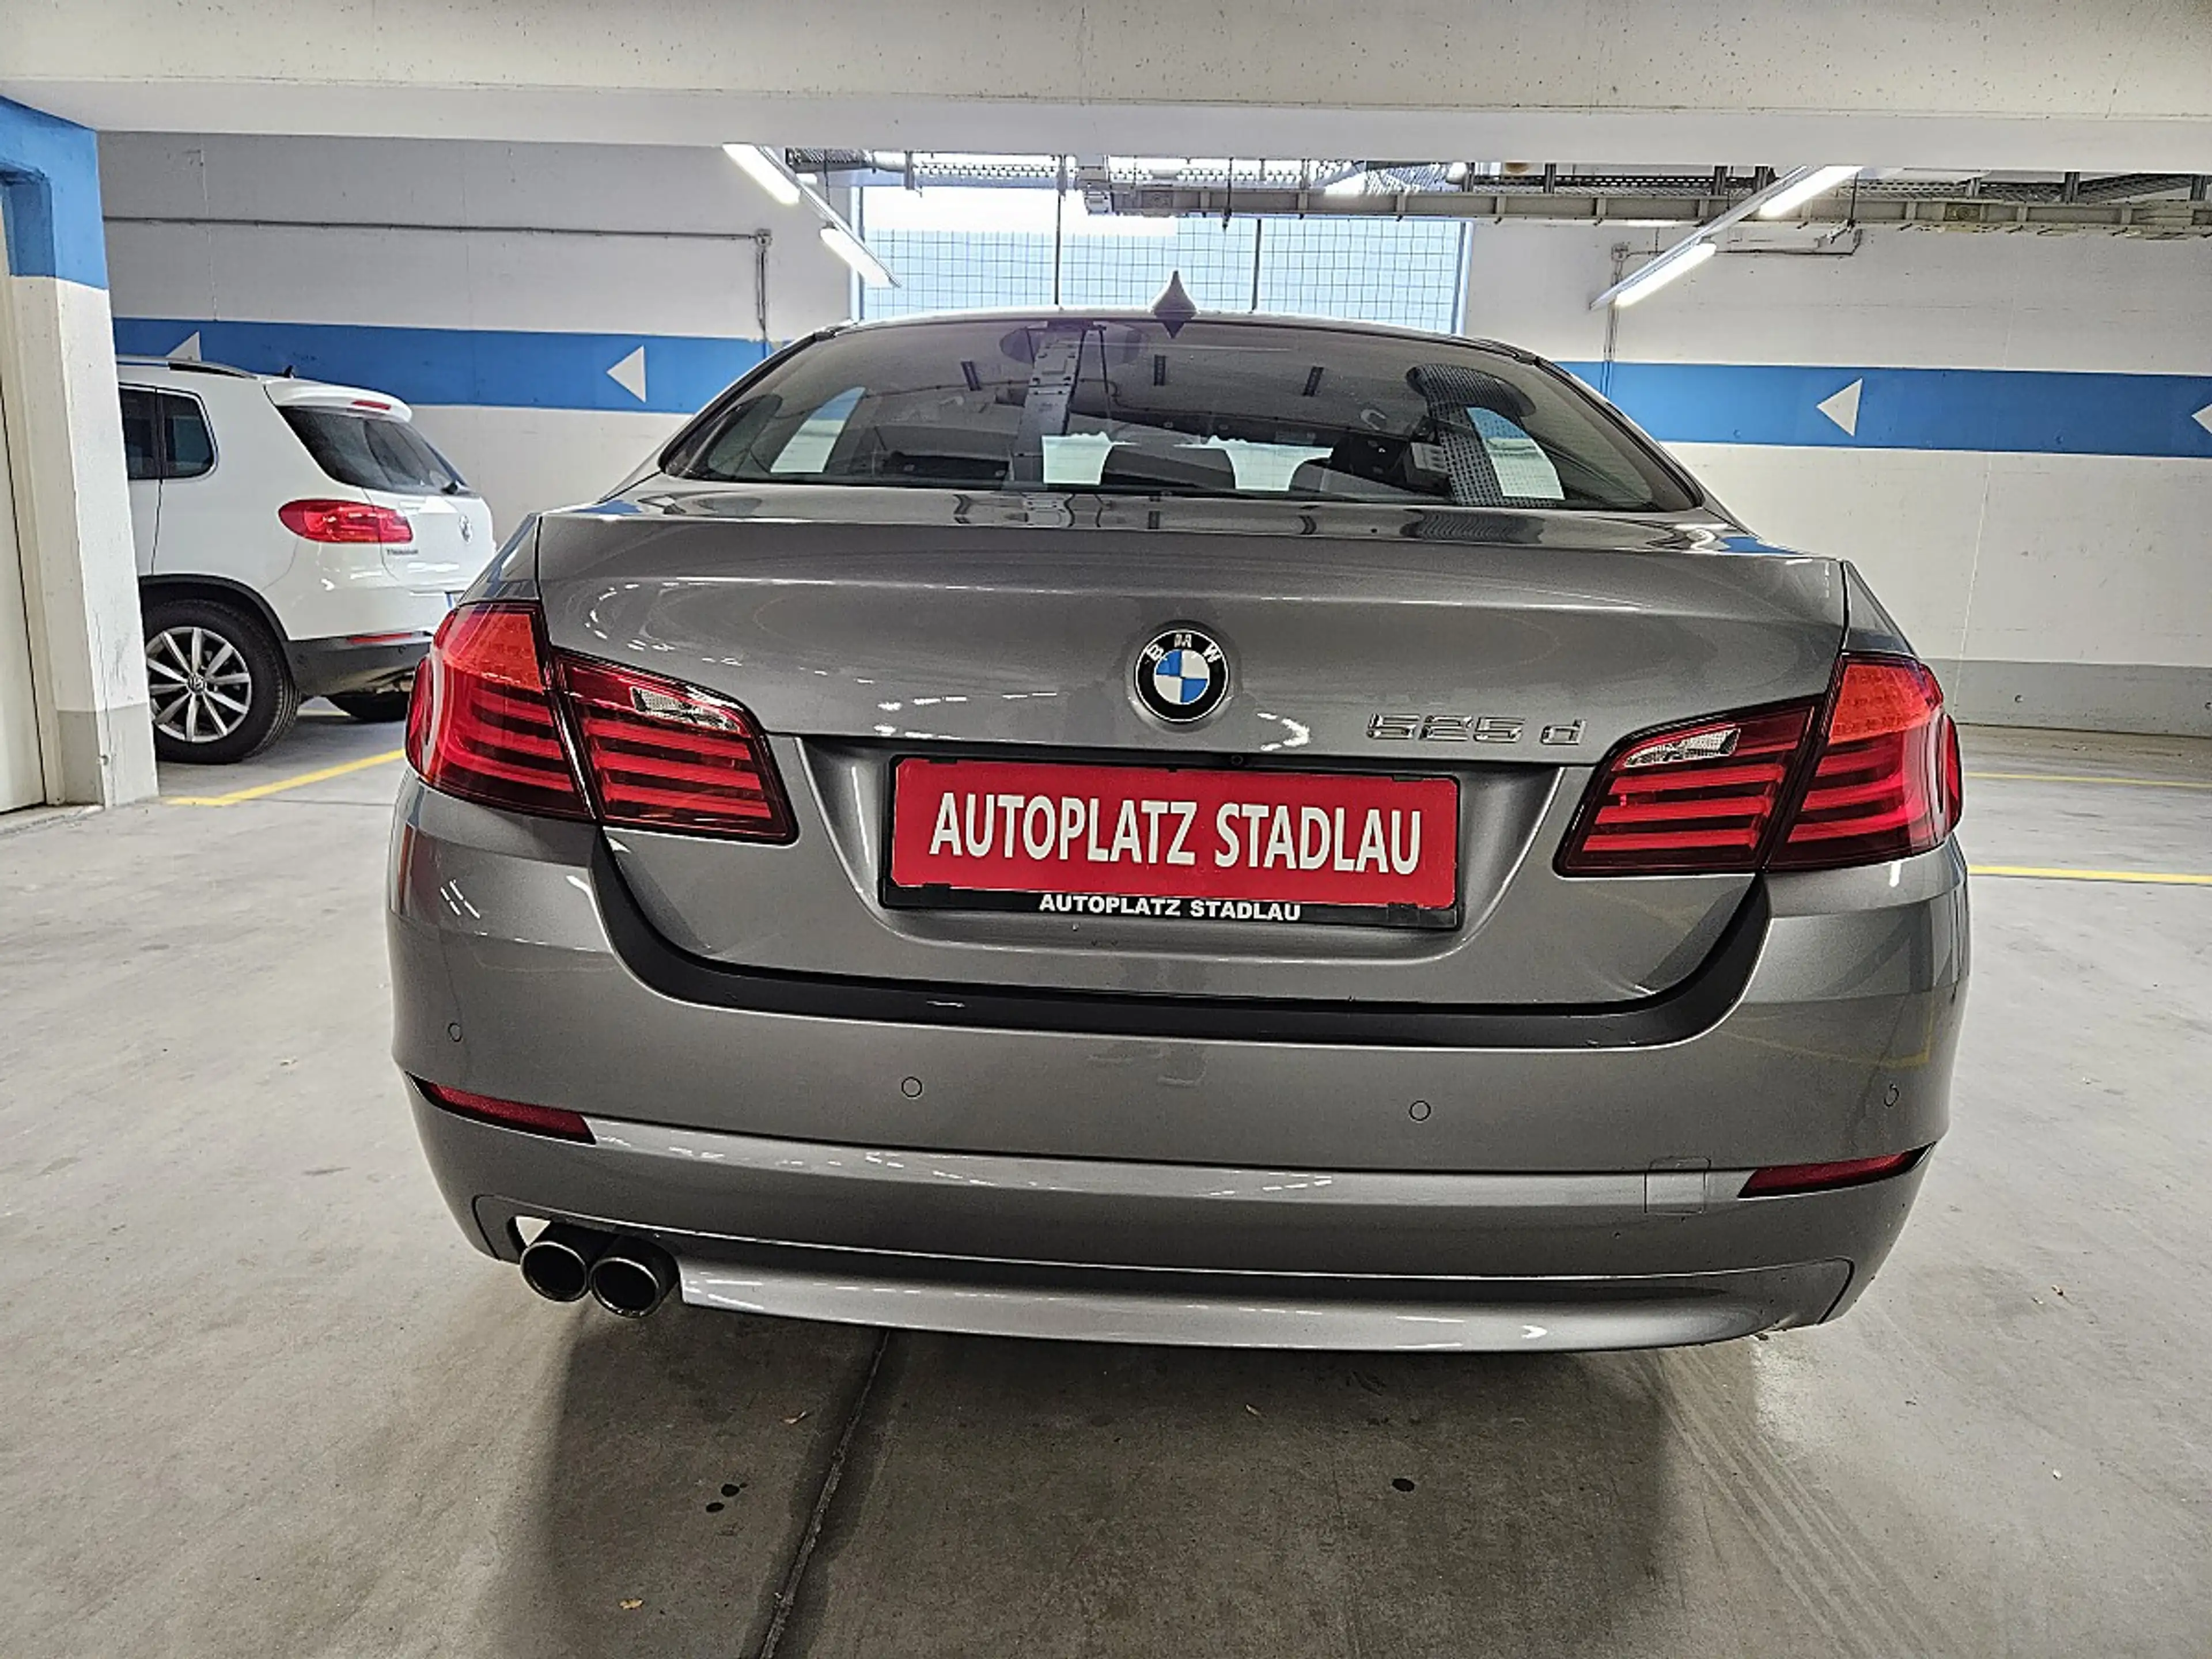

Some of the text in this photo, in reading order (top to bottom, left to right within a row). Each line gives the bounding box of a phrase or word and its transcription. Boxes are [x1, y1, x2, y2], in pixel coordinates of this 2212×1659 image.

[1146, 634, 1222, 662] BMW
[1366, 714, 1588, 745] 525 d
[929, 792, 1421, 874] AUTOPLATZ STADLAU
[1039, 894, 1301, 921] AUTOPLATZ STADLAU
